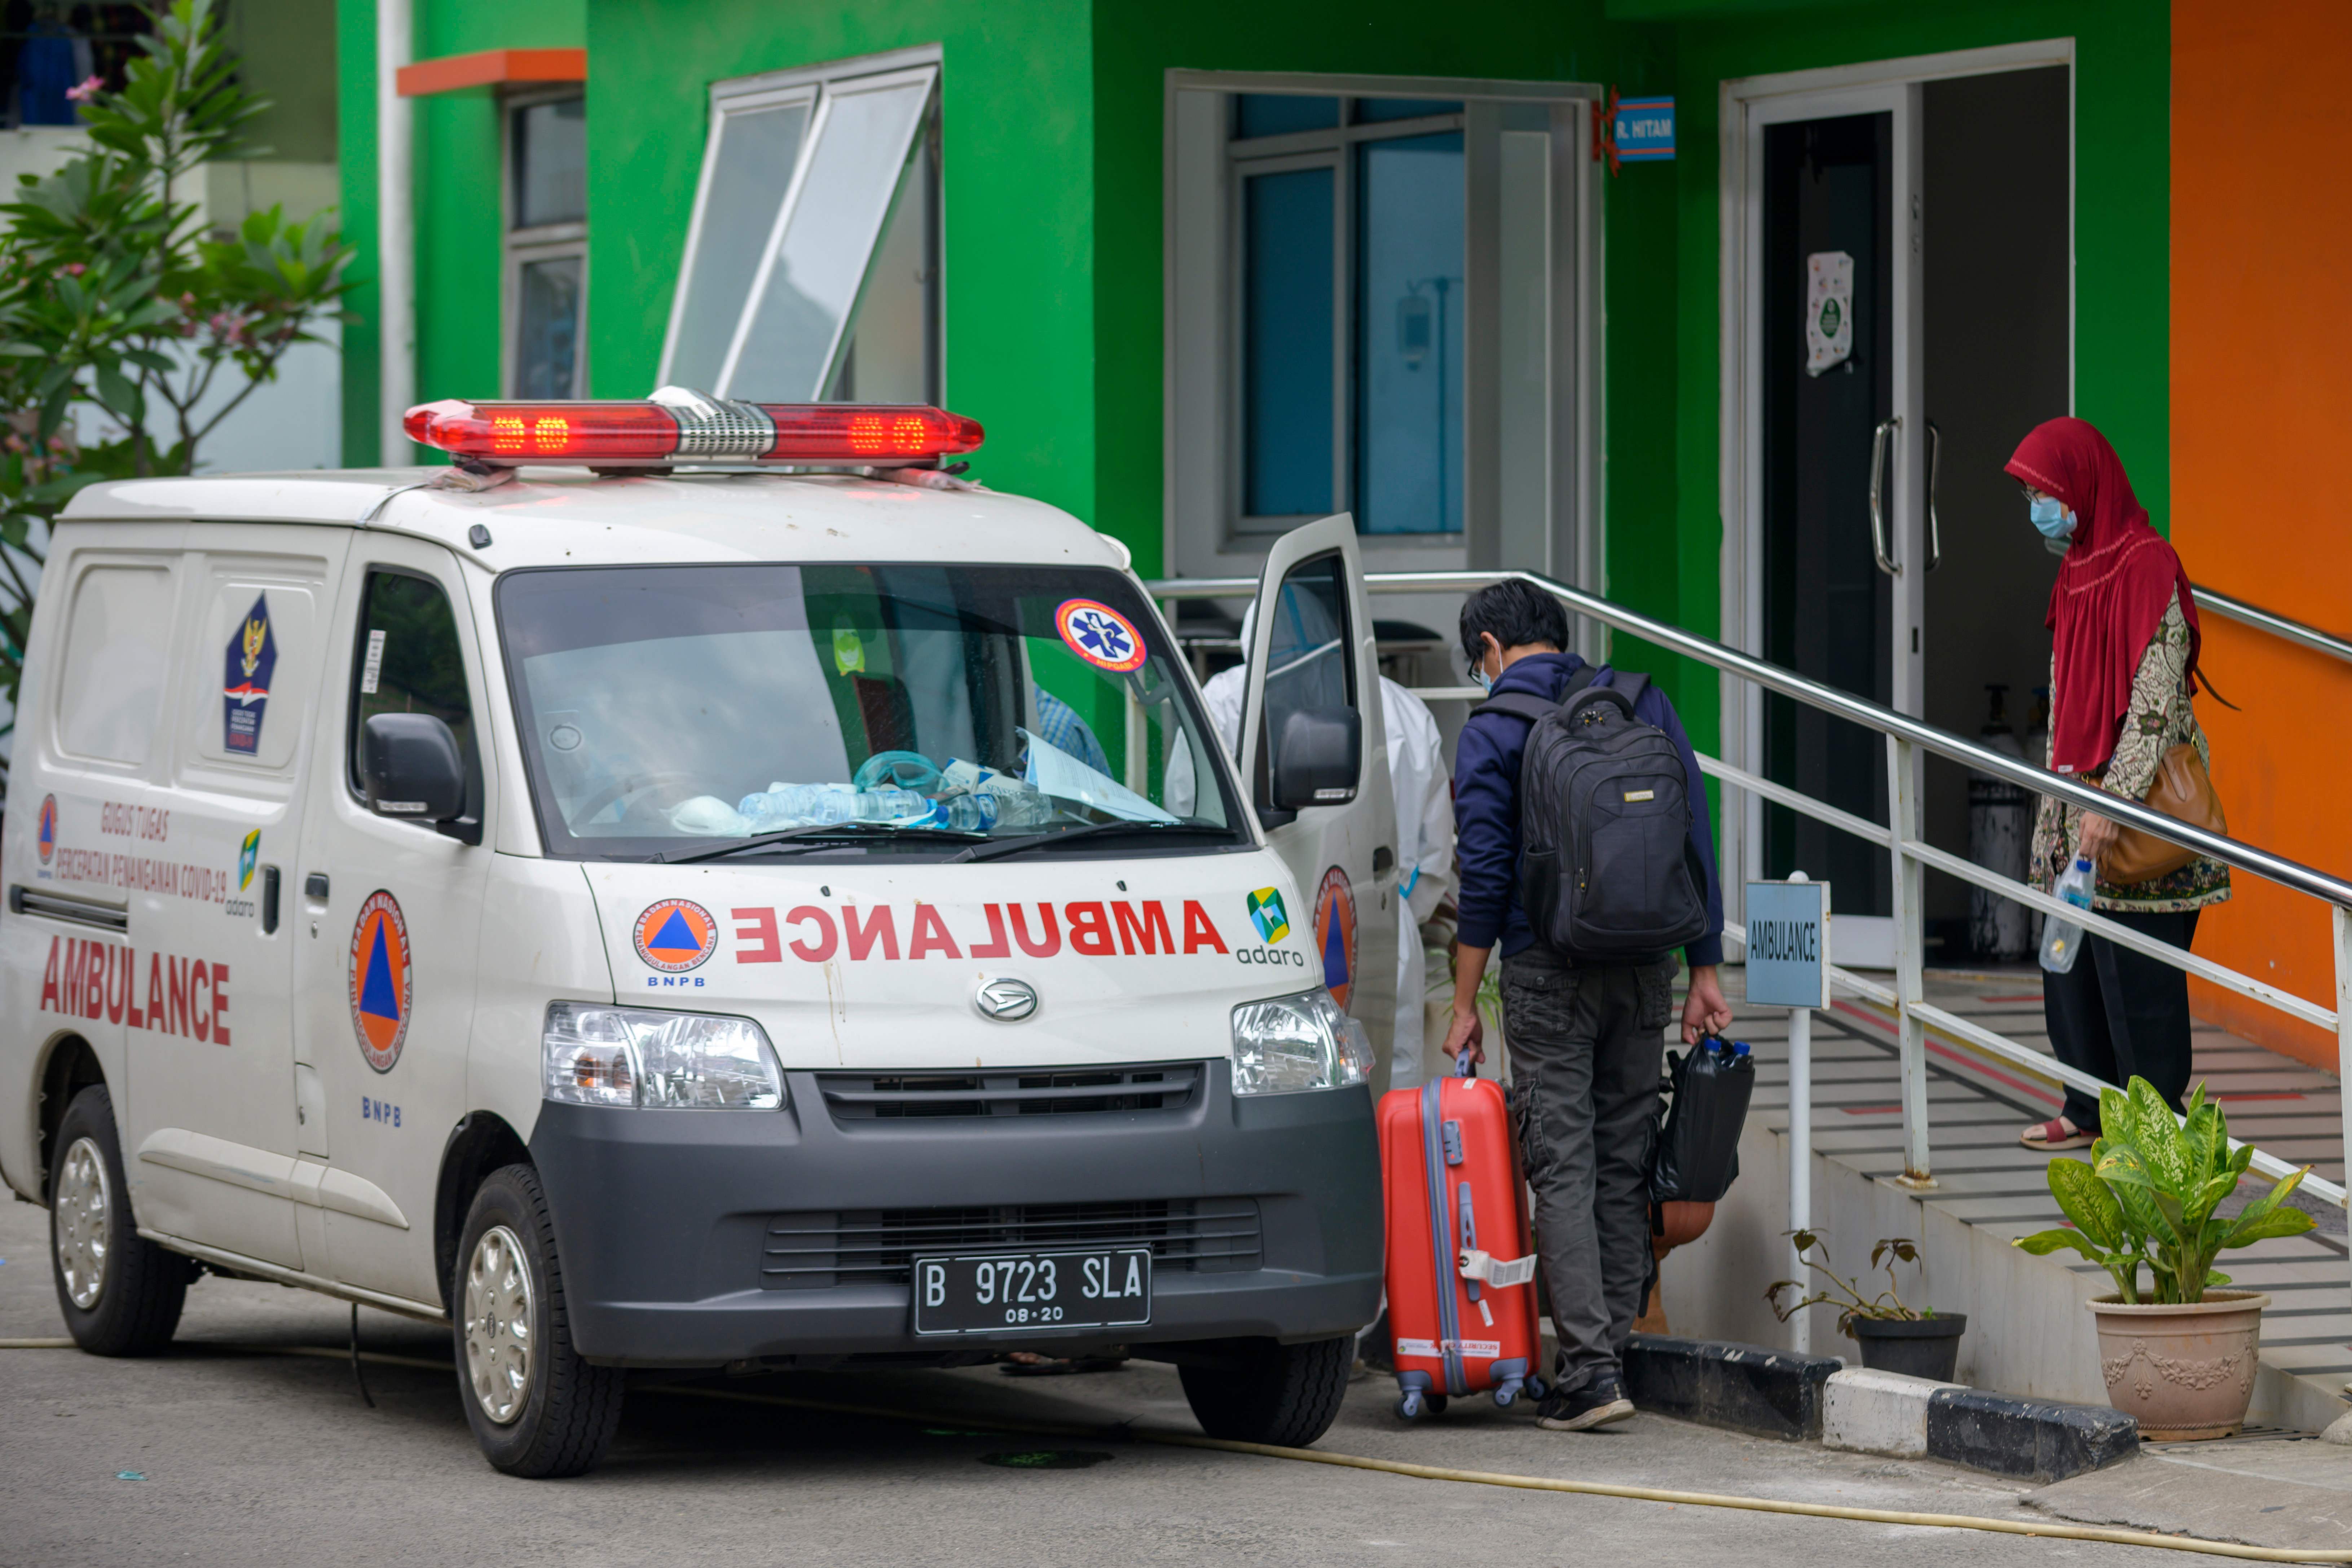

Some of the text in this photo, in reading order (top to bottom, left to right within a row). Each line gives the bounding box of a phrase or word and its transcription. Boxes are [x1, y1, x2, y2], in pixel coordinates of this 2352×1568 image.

[1617, 119, 1672, 139] R. HITAM
[102, 801, 169, 842] GUGUS TUGAS
[182, 864, 226, 904] COVID-19
[226, 897, 254, 917] adaro
[640, 900, 713, 928] BADAN NASIONAL
[353, 894, 408, 962] BADAN NASIONAL
[1751, 920, 1815, 962] AMBULANCE
[636, 930, 715, 970] PENANGGULANGAN BENCANA
[1237, 944, 1304, 967] adaro
[40, 935, 231, 1046] AMBULANCE
[648, 977, 705, 987] BNPB
[393, 981, 410, 1055] BENCANA
[362, 1096, 401, 1128] BNPB
[926, 1255, 1142, 1307] B 9723 SLA
[1458, 1342, 1498, 1350] SECURITY
